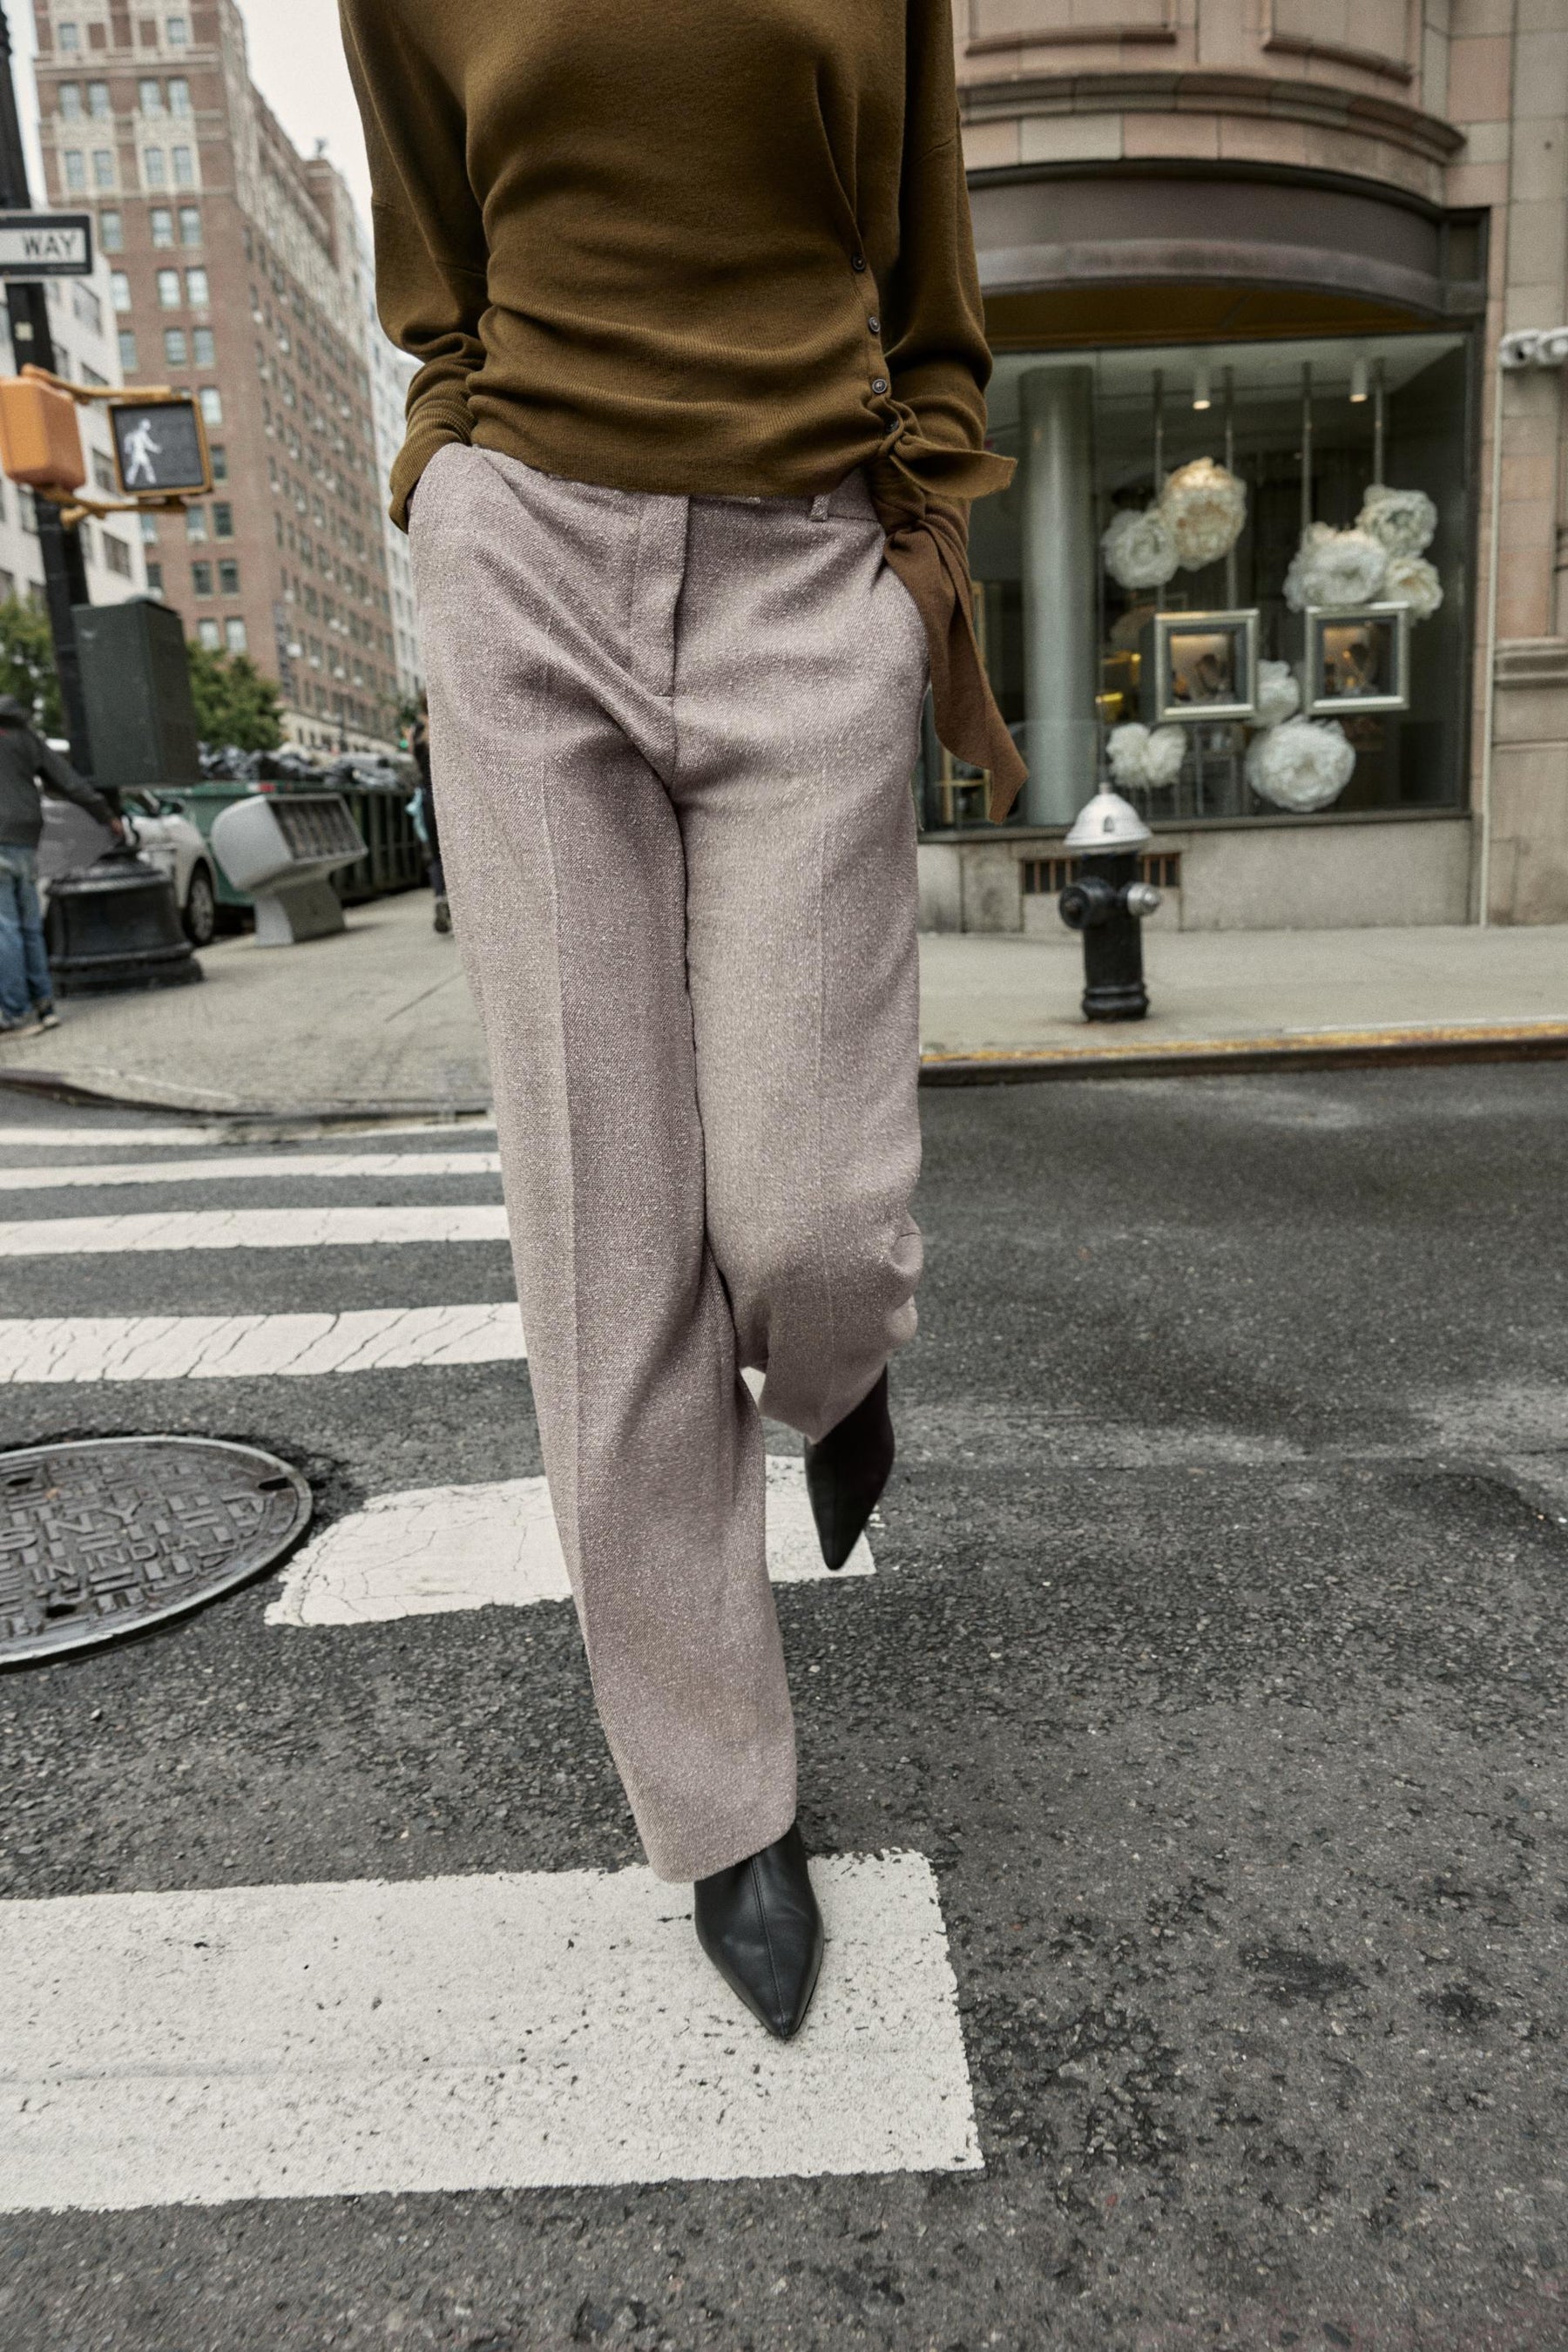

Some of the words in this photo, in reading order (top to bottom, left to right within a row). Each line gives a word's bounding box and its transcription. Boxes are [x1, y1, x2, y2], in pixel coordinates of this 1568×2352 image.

[21, 233, 77, 257] WAY
[32, 1560, 76, 1585] IN
[85, 1534, 200, 1572] INDIA
